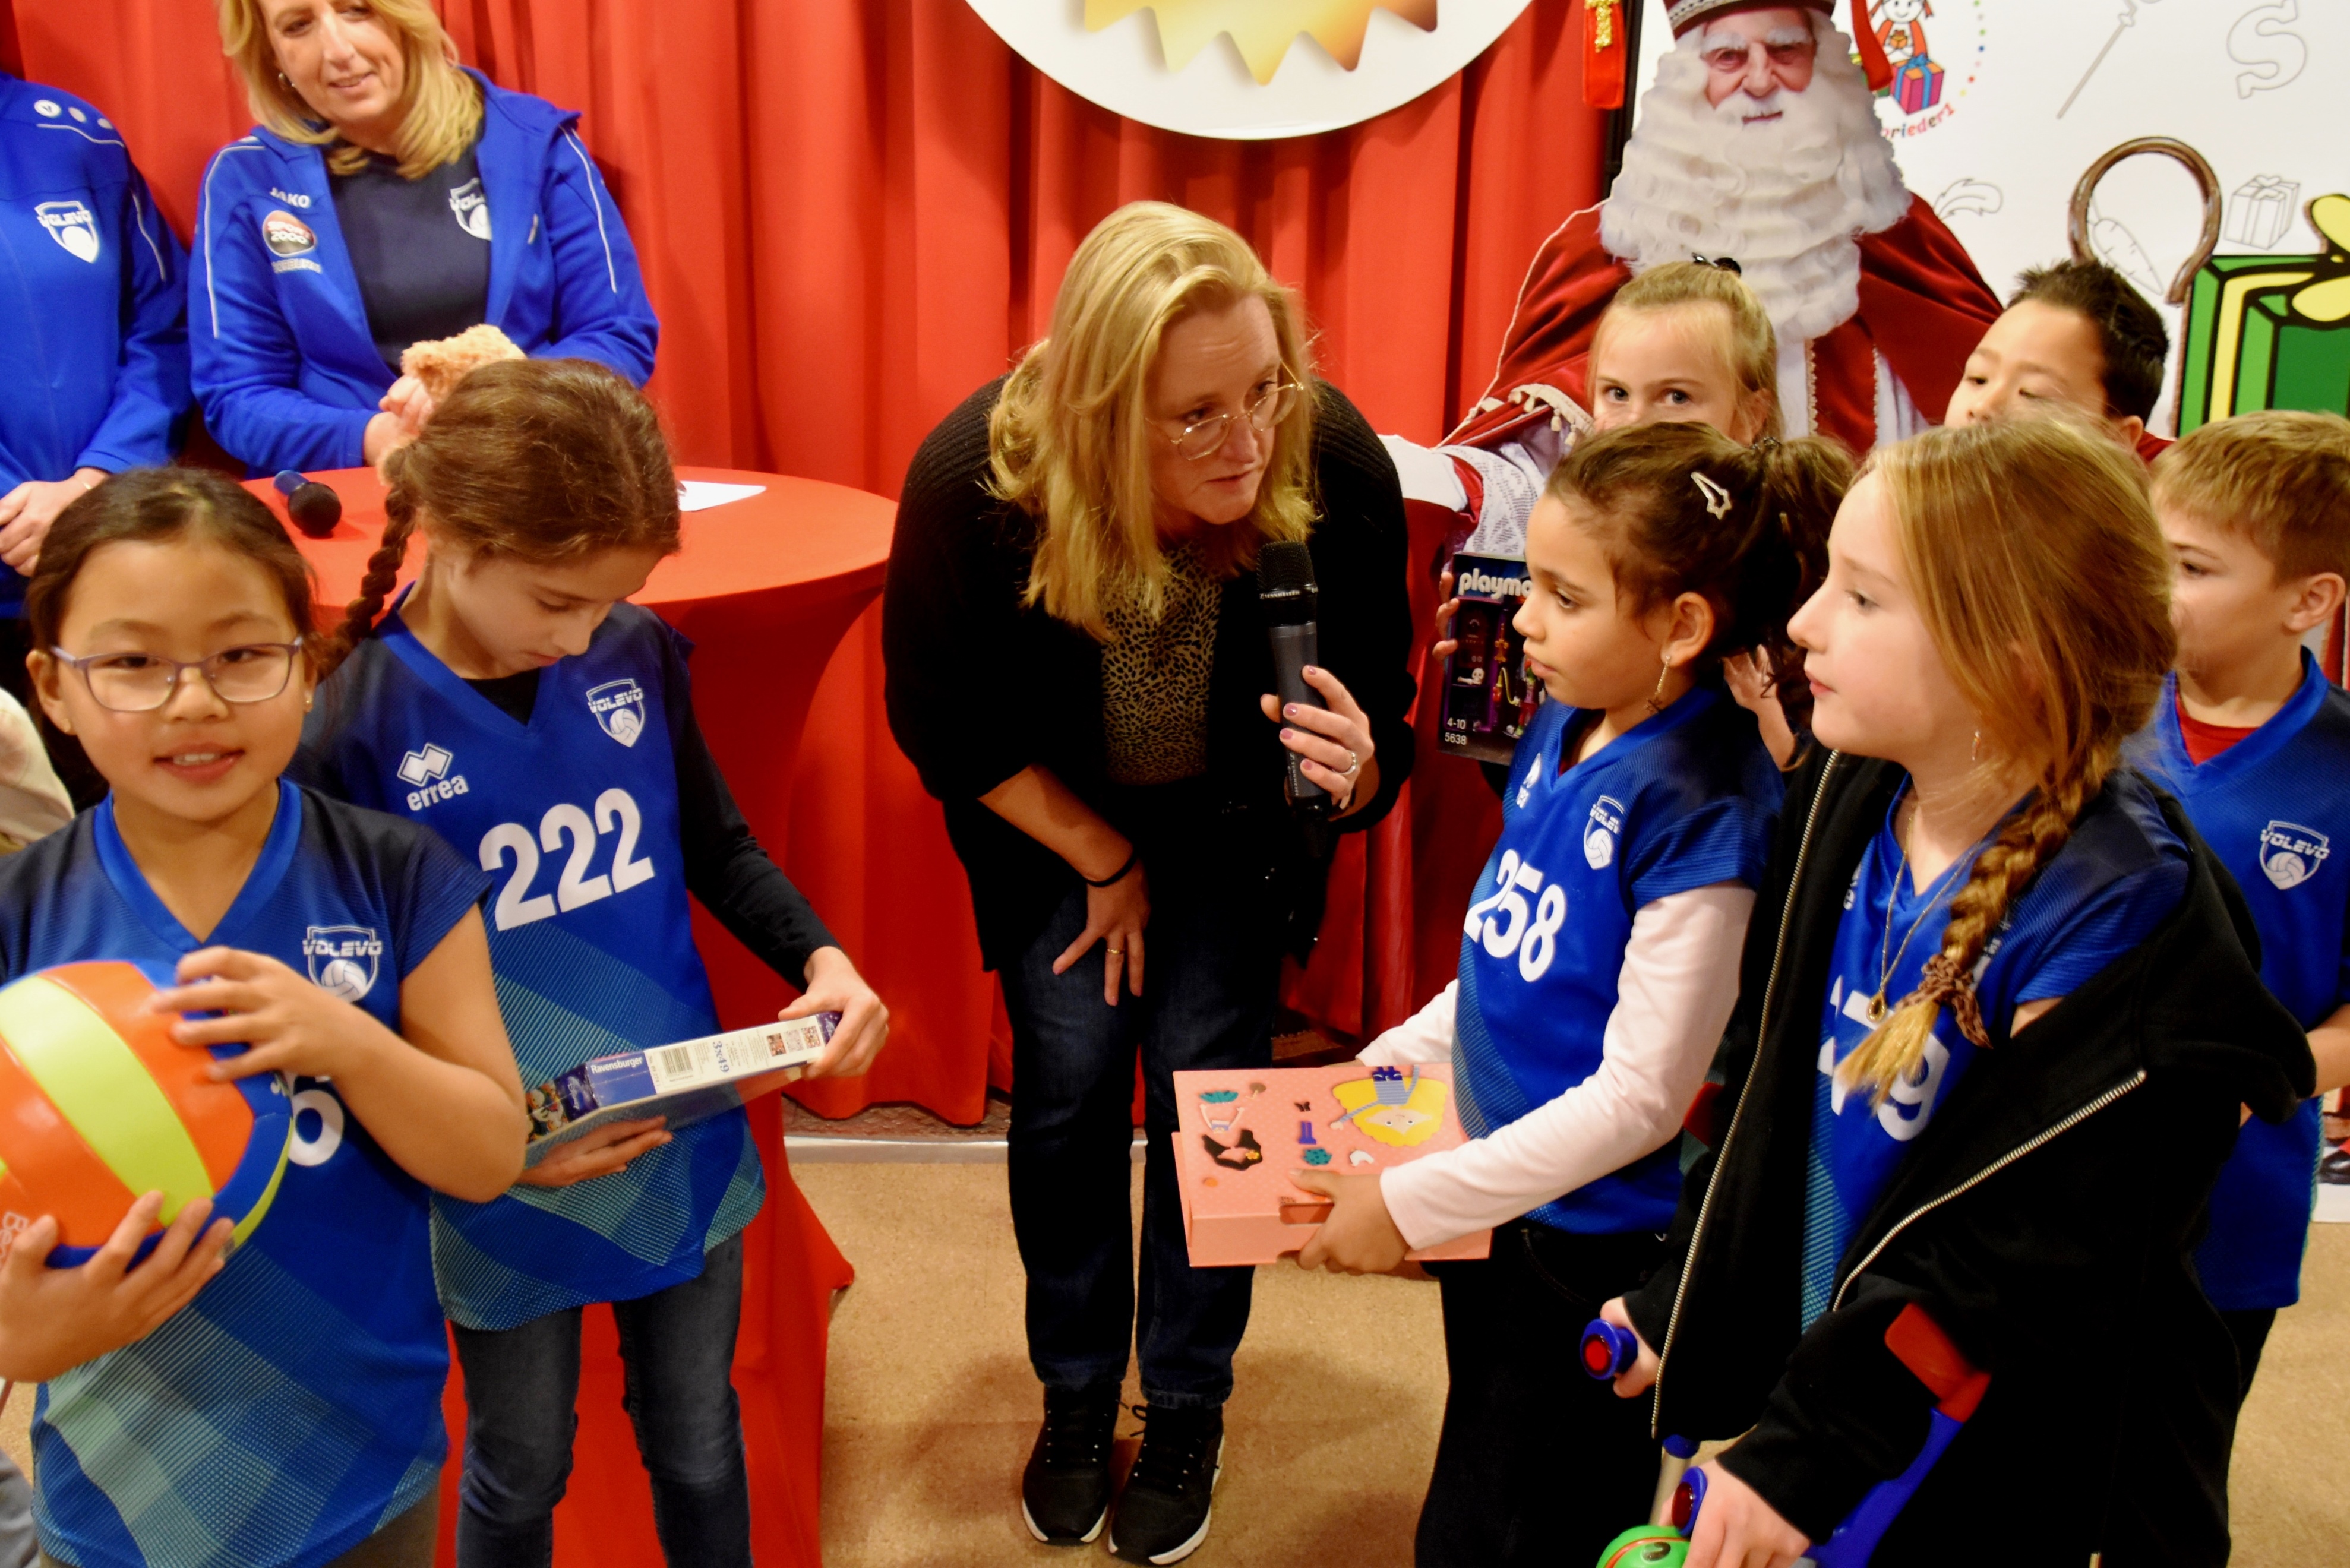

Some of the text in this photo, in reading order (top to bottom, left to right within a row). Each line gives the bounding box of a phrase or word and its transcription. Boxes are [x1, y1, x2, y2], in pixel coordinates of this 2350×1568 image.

[269, 187, 311, 208] JAKO
[36, 209, 92, 228] VOLEVO
[267, 220, 311, 239] SPORT
[271, 230, 309, 245] 2000
[587, 687, 643, 713] VOLEVO
[1447, 717, 1467, 730] 4-10
[1444, 732, 1467, 745] 5638
[2260, 829, 2330, 859] VOLEVO
[478, 788, 655, 932] 222
[1463, 849, 1567, 983] 258
[302, 936, 383, 957] VOLEVO
[590, 1056, 643, 1074] Ravensburger
[712, 1041, 730, 1073] 3x49
